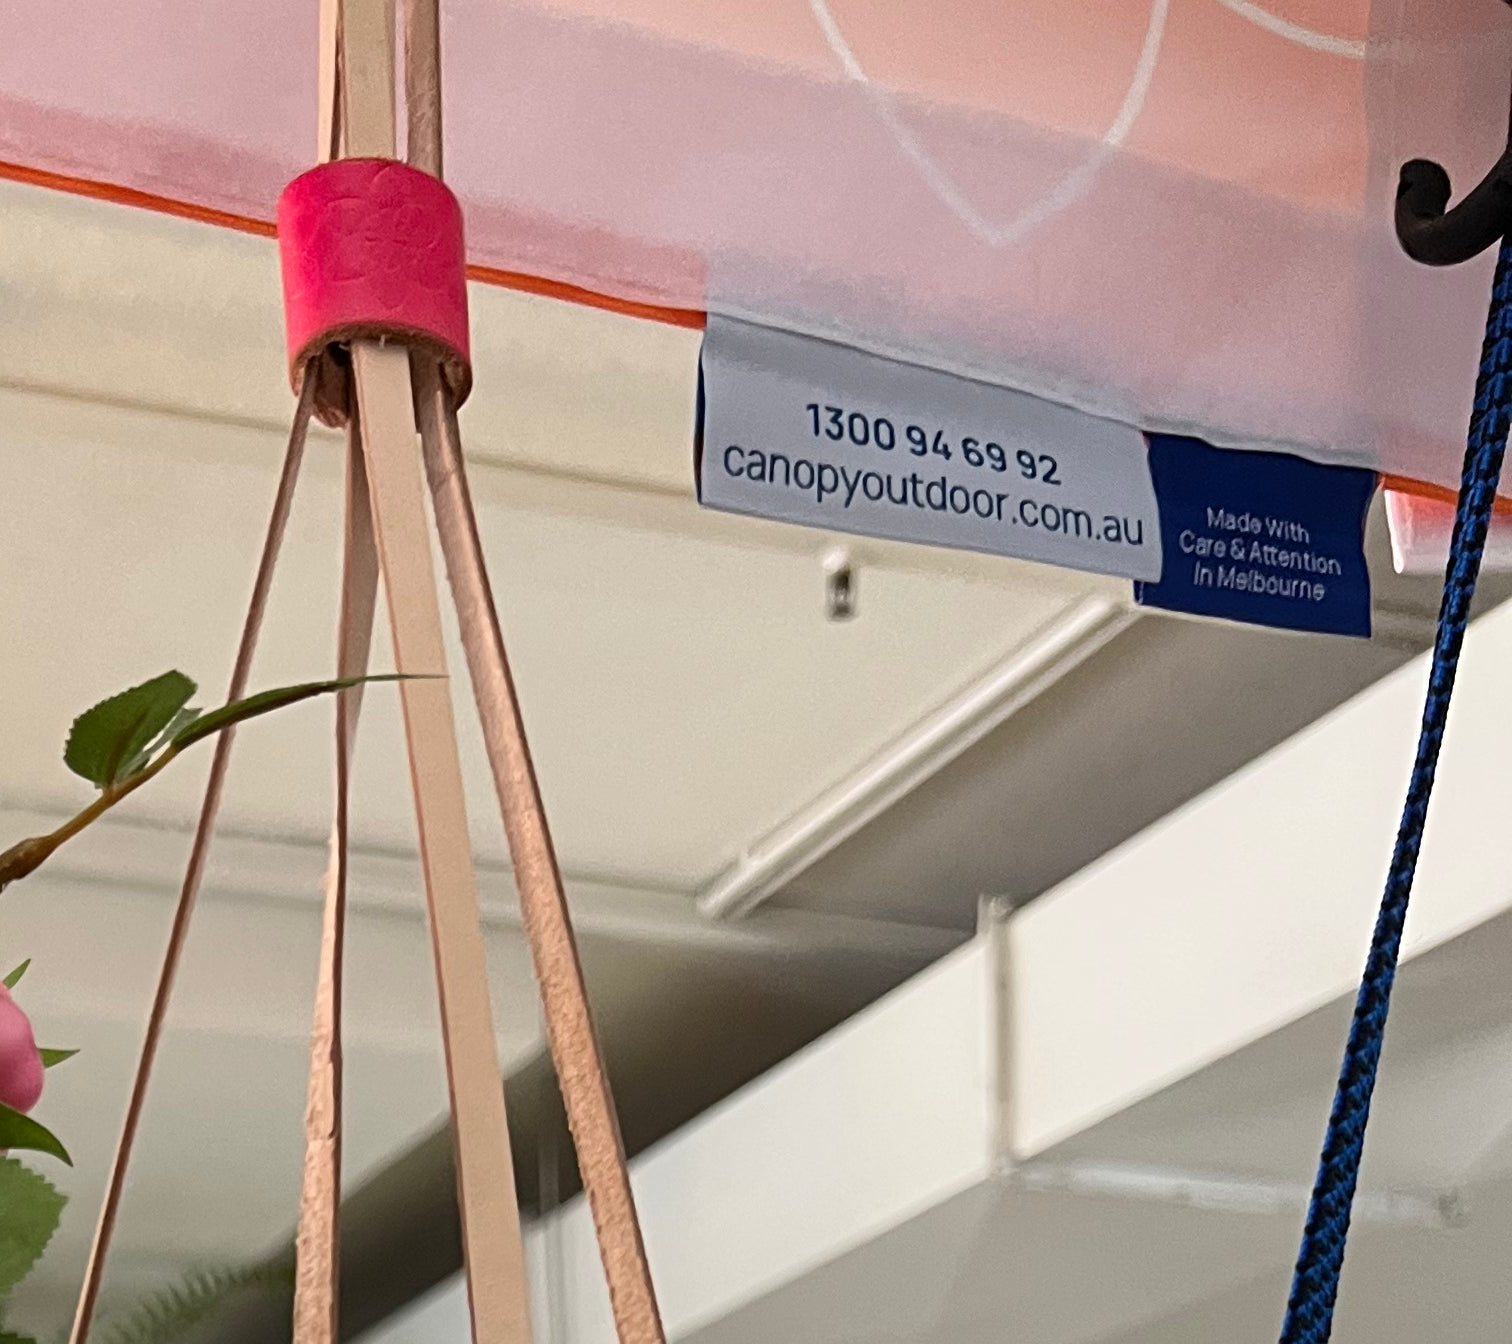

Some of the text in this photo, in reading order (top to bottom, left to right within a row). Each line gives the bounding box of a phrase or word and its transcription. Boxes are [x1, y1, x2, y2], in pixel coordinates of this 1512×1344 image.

[806, 402, 1063, 486] 1300 94 69 92
[723, 444, 1144, 546] canopyoutdoor.com.au
[1206, 505, 1262, 534] Made
[1178, 528, 1342, 576] Care & Attention
[1193, 560, 1326, 602] In Melbourne
